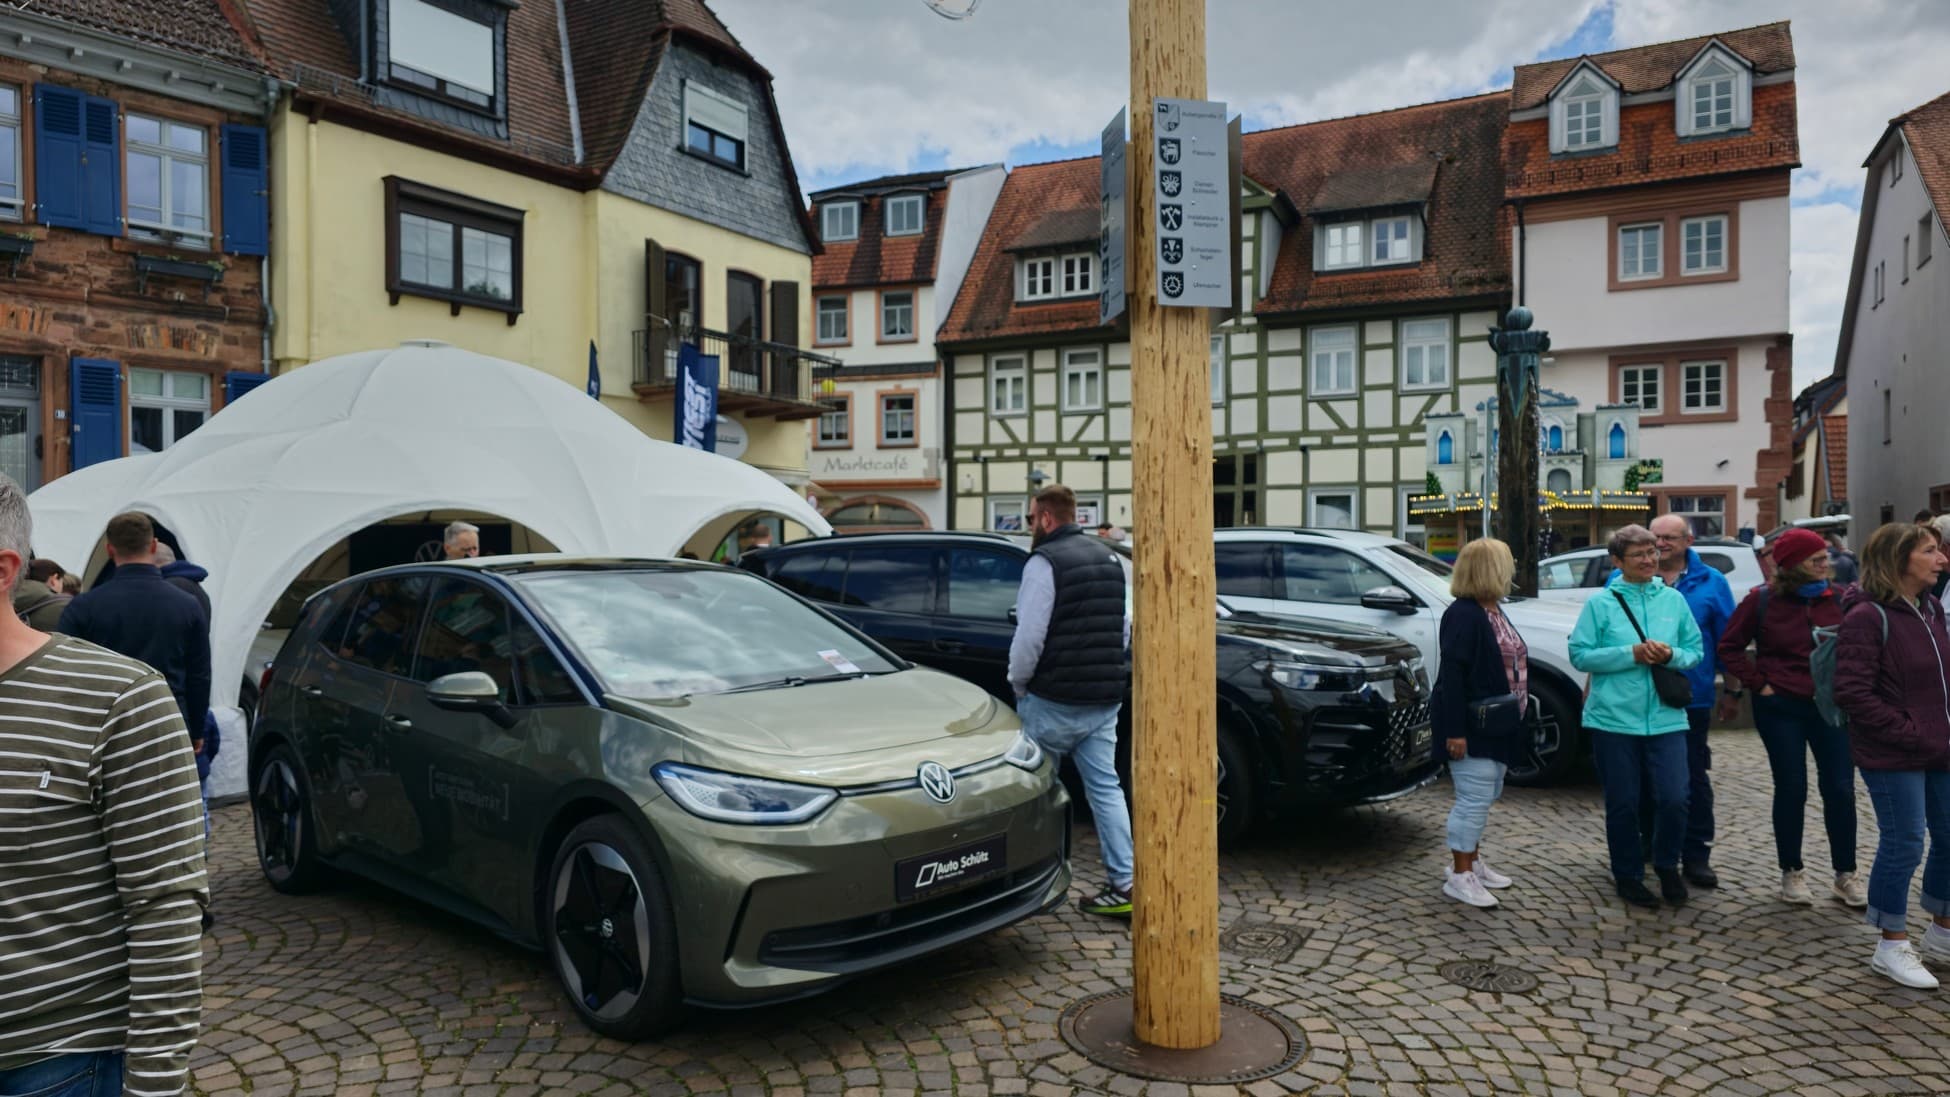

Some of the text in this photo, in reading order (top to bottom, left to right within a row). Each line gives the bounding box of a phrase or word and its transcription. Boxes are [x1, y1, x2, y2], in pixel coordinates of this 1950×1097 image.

[823, 454, 908, 474] Marktcafé
[937, 860, 959, 875] Auto
[960, 851, 989, 869] Schütz
